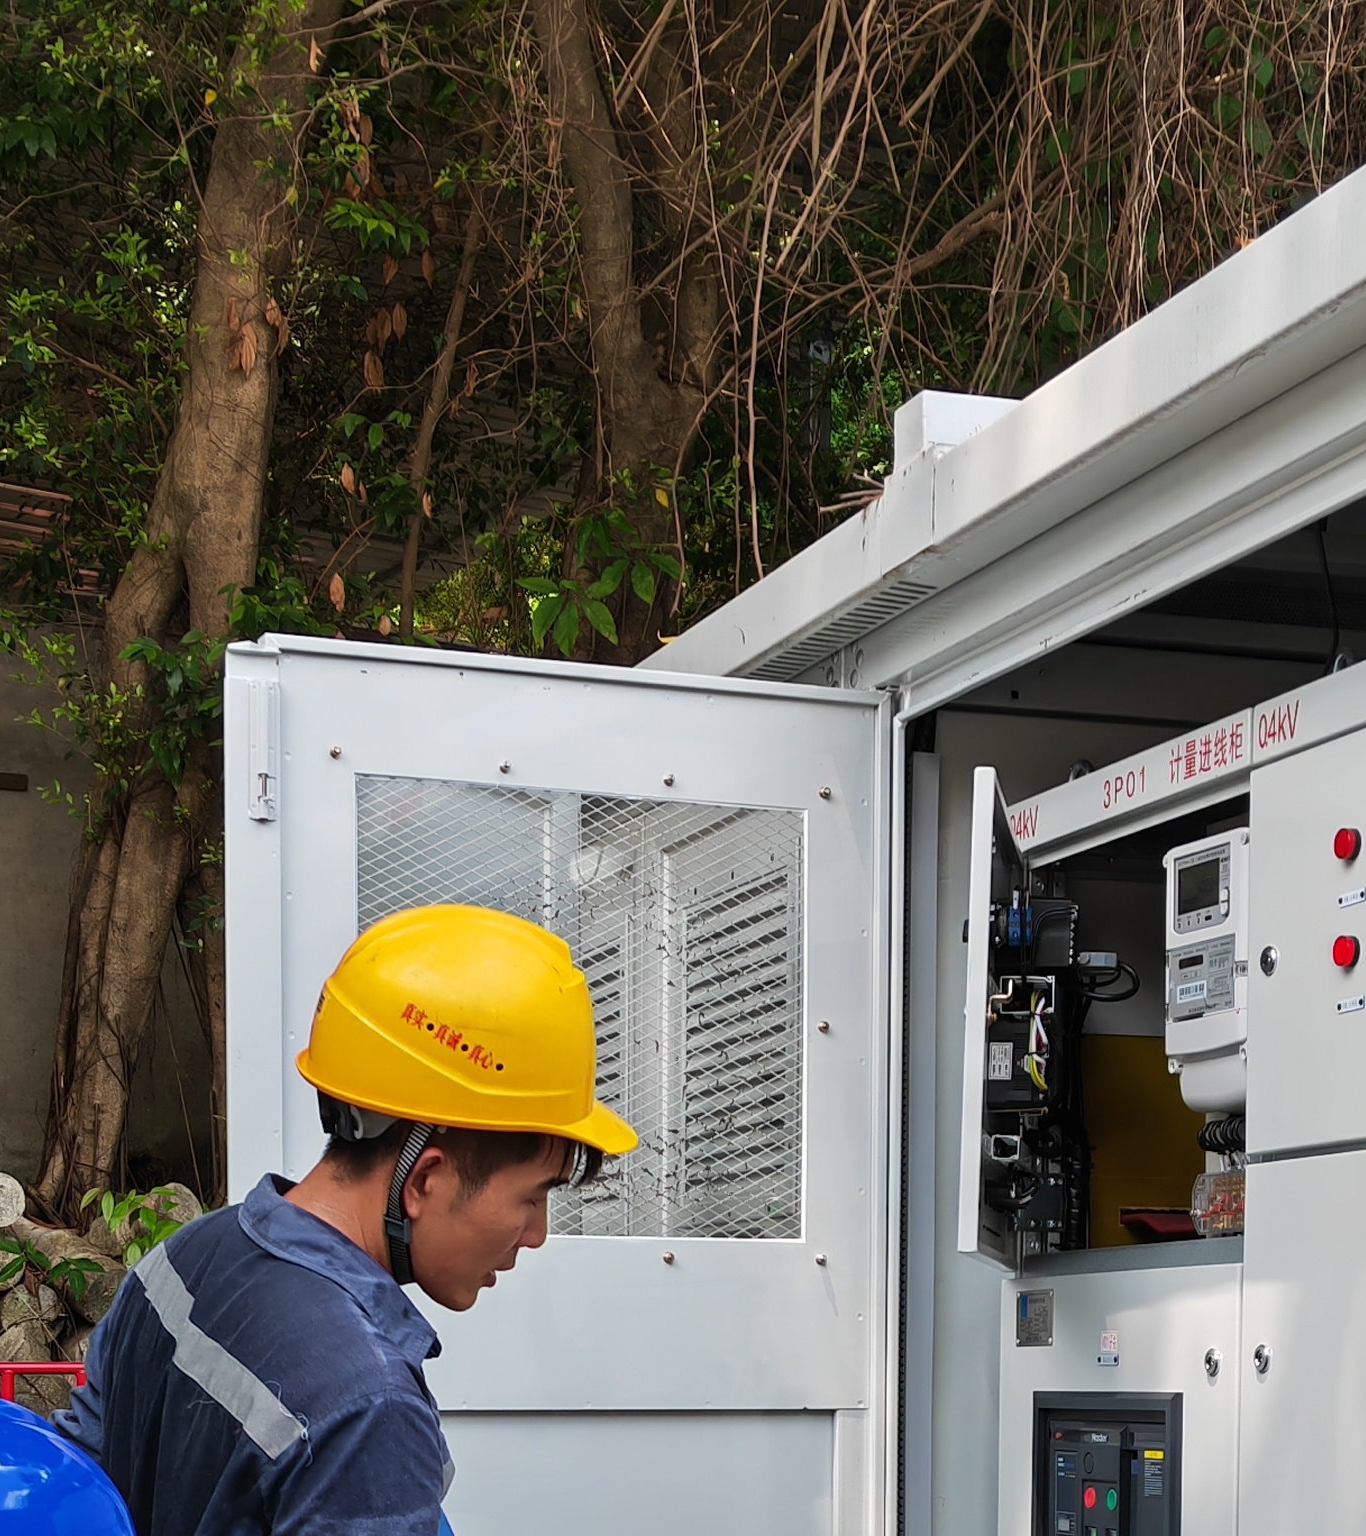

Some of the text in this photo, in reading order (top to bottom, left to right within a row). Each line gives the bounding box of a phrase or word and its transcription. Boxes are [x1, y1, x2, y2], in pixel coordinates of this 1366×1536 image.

[1169, 722, 1243, 784] 计量进线柜
[1091, 1432, 1109, 1442] Nader
